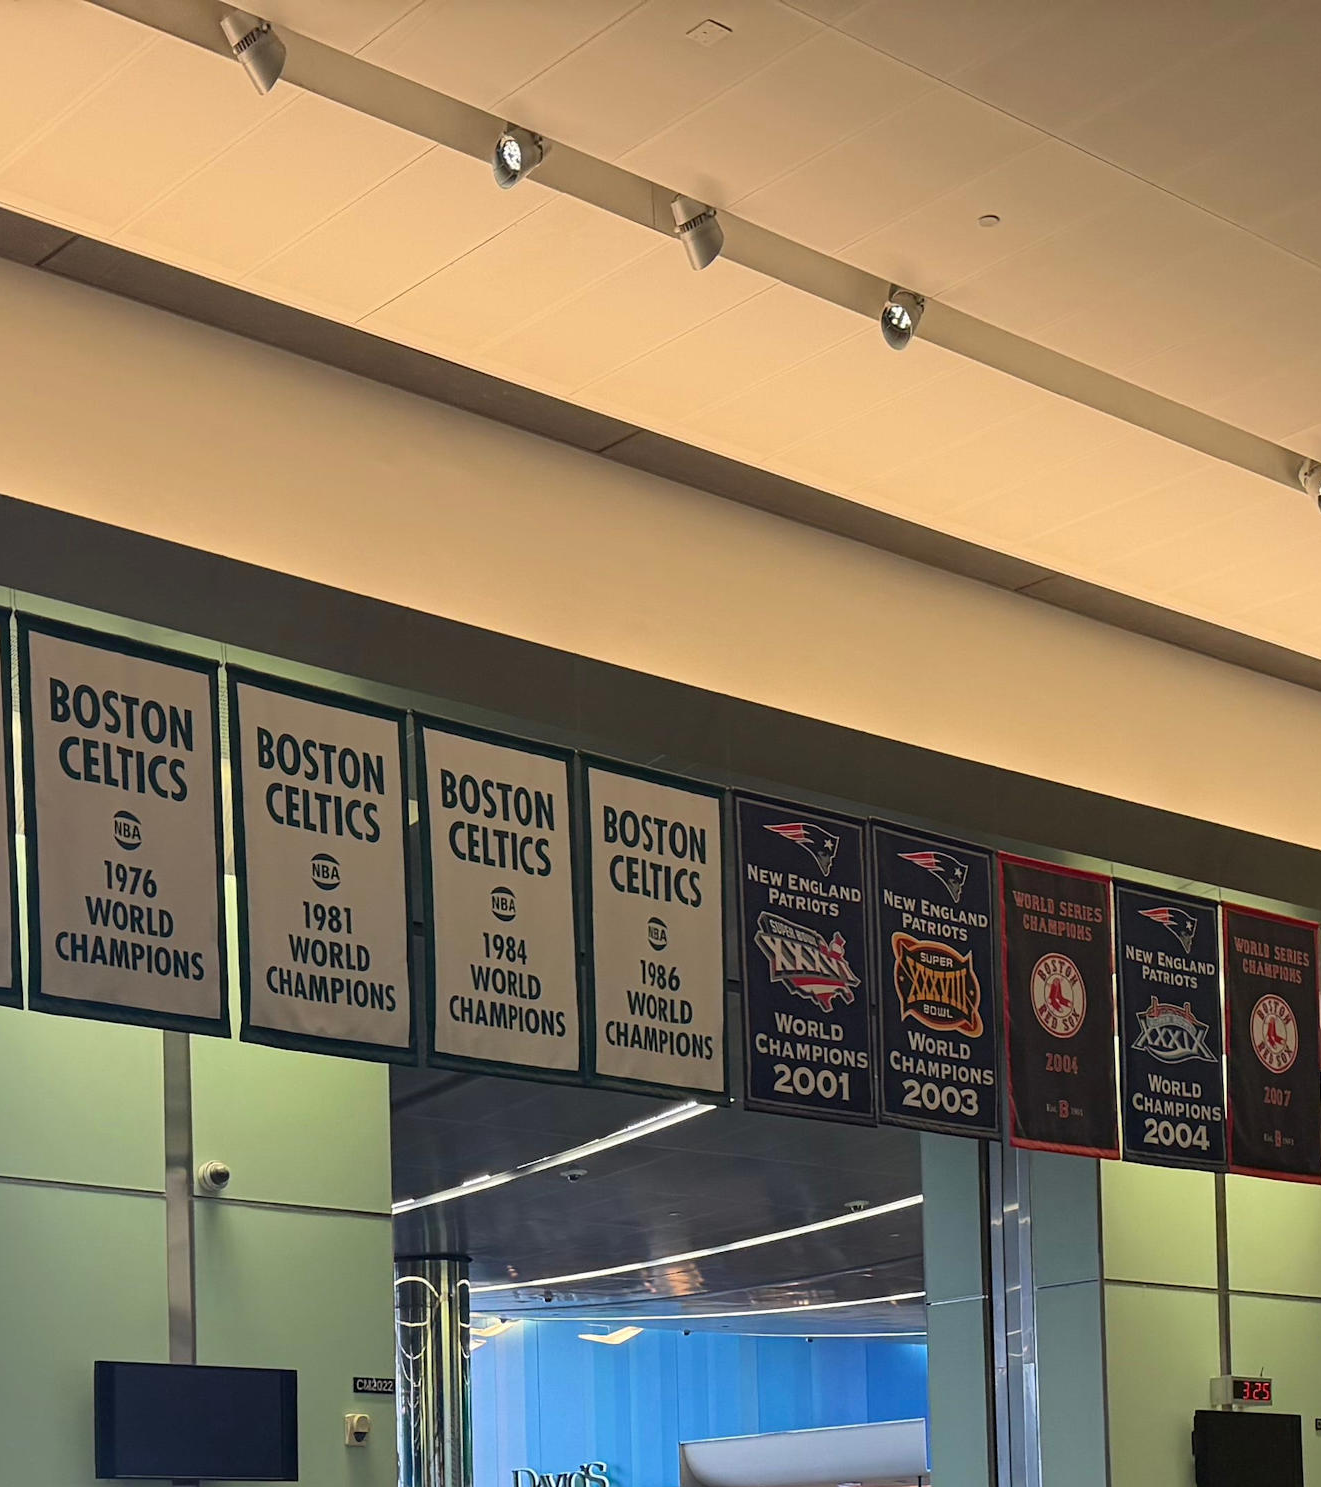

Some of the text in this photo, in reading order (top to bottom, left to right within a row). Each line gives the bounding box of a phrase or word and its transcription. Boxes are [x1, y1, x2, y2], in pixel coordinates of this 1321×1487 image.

[50, 677, 193, 752] BOSTON
[59, 736, 188, 802] CELTICS
[257, 727, 384, 795] BOSTON
[266, 783, 380, 843] CELTICS
[441, 769, 554, 831] BOSTON
[115, 820, 142, 841] NBA
[604, 805, 706, 865] BOSTON
[449, 820, 551, 876] CELTICS
[104, 860, 157, 898] 1976
[312, 862, 339, 881] NBA
[610, 855, 702, 909] CELTICS
[748, 864, 862, 903] NEW ENGLAND
[85, 896, 174, 939] WORLD
[303, 901, 351, 935] 1981
[492, 896, 516, 914] NBA
[769, 887, 839, 917] PATRIOTS
[884, 889, 988, 928] NEW ENGLAND
[1013, 891, 1103, 923] WORLD SERIES
[648, 927, 667, 944] NBA
[902, 913, 968, 942] PATRIOTS
[1023, 917, 1092, 942] CHAMPIONS
[55, 931, 204, 981] CHAMPIONS
[289, 934, 370, 972] WORLD
[483, 933, 527, 965] 1984
[920, 952, 953, 968] SUPER
[1126, 945, 1215, 975] NEW ENGLAND
[1234, 937, 1310, 967] WORLD SERIES
[471, 964, 541, 1001] WORLD
[640, 959, 680, 991] 1986
[906, 958, 967, 1009] XXXVIII
[1038, 958, 1079, 986] BOSTON
[1142, 965, 1198, 989] PATRIOTS
[1242, 958, 1302, 985] CHAMPIONS
[266, 966, 396, 1013] CHAMPIONS
[450, 995, 565, 1037] CHAMPIONS
[627, 990, 692, 1025] WORLD
[923, 1003, 953, 1019] BOWL
[1038, 1004, 1081, 1031] RED SOX
[1257, 1000, 1292, 1025] BOSTON
[606, 1021, 713, 1061] CHAMPIONS
[774, 1012, 843, 1041] WORLD
[1136, 1018, 1212, 1058] XXXIX
[756, 1033, 868, 1069] CHAMPIONS
[908, 1031, 971, 1061] WORLD
[773, 1063, 851, 1101] 2001
[890, 1051, 994, 1086] CHAMPIONS
[1148, 1073, 1201, 1098] WORLD
[902, 1079, 978, 1117] 2003
[1132, 1092, 1221, 1122] CHAMPIONS
[1264, 1086, 1292, 1108] 2007
[1144, 1118, 1210, 1151] 2004
